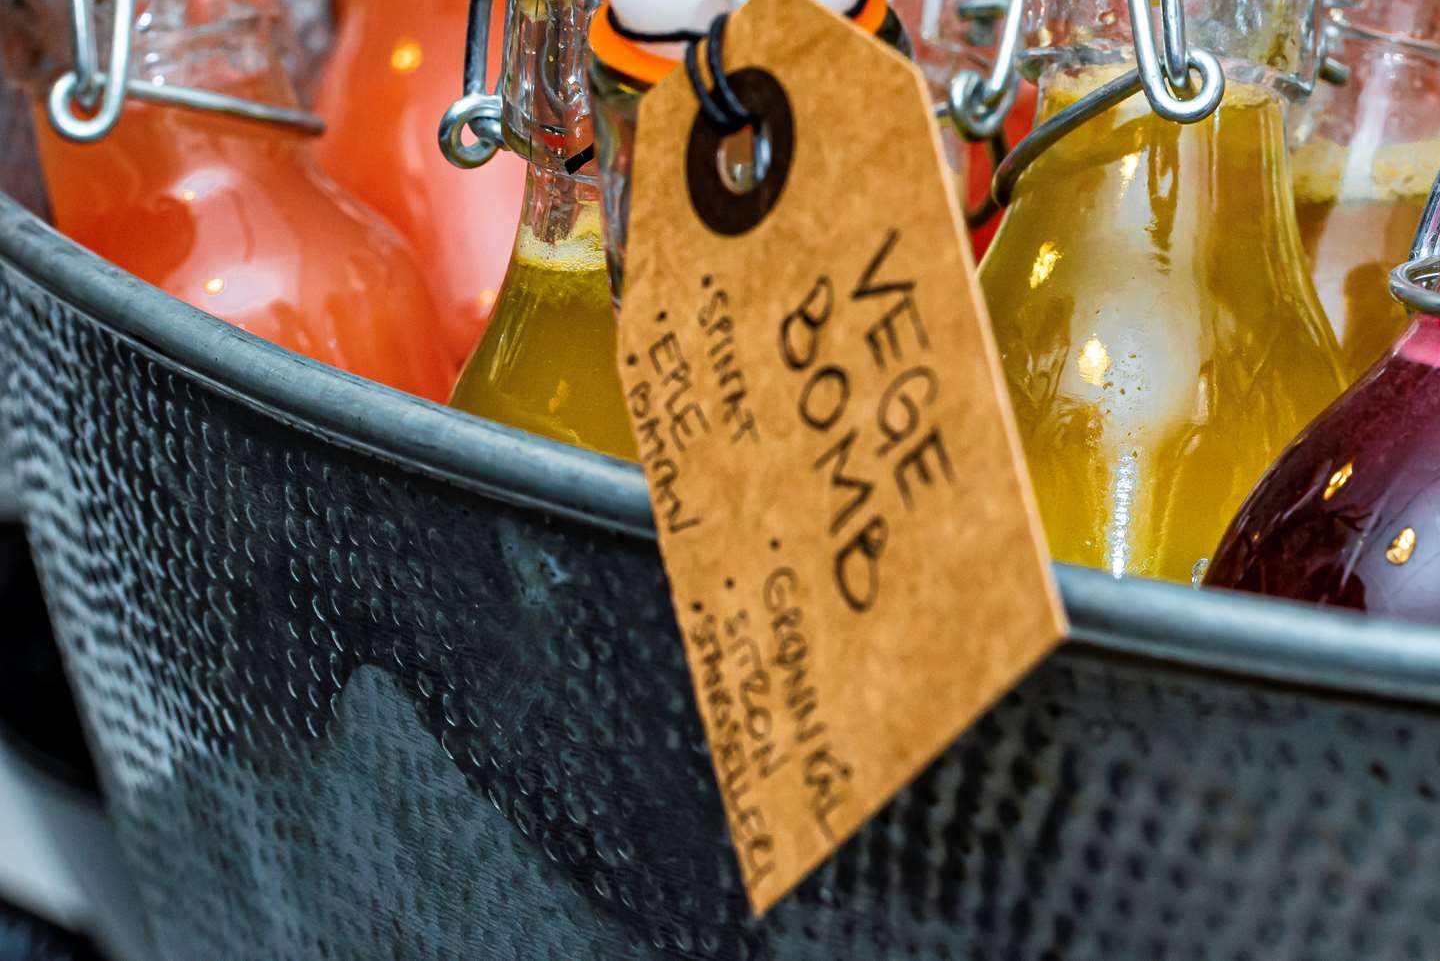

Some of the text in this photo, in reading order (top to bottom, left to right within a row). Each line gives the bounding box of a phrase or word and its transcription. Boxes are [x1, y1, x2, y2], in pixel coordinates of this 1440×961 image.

[649, 330, 709, 451] EPLE
[699, 289, 757, 445] SPINAT
[779, 276, 888, 611] BOMB
[850, 230, 954, 511] VEGE
